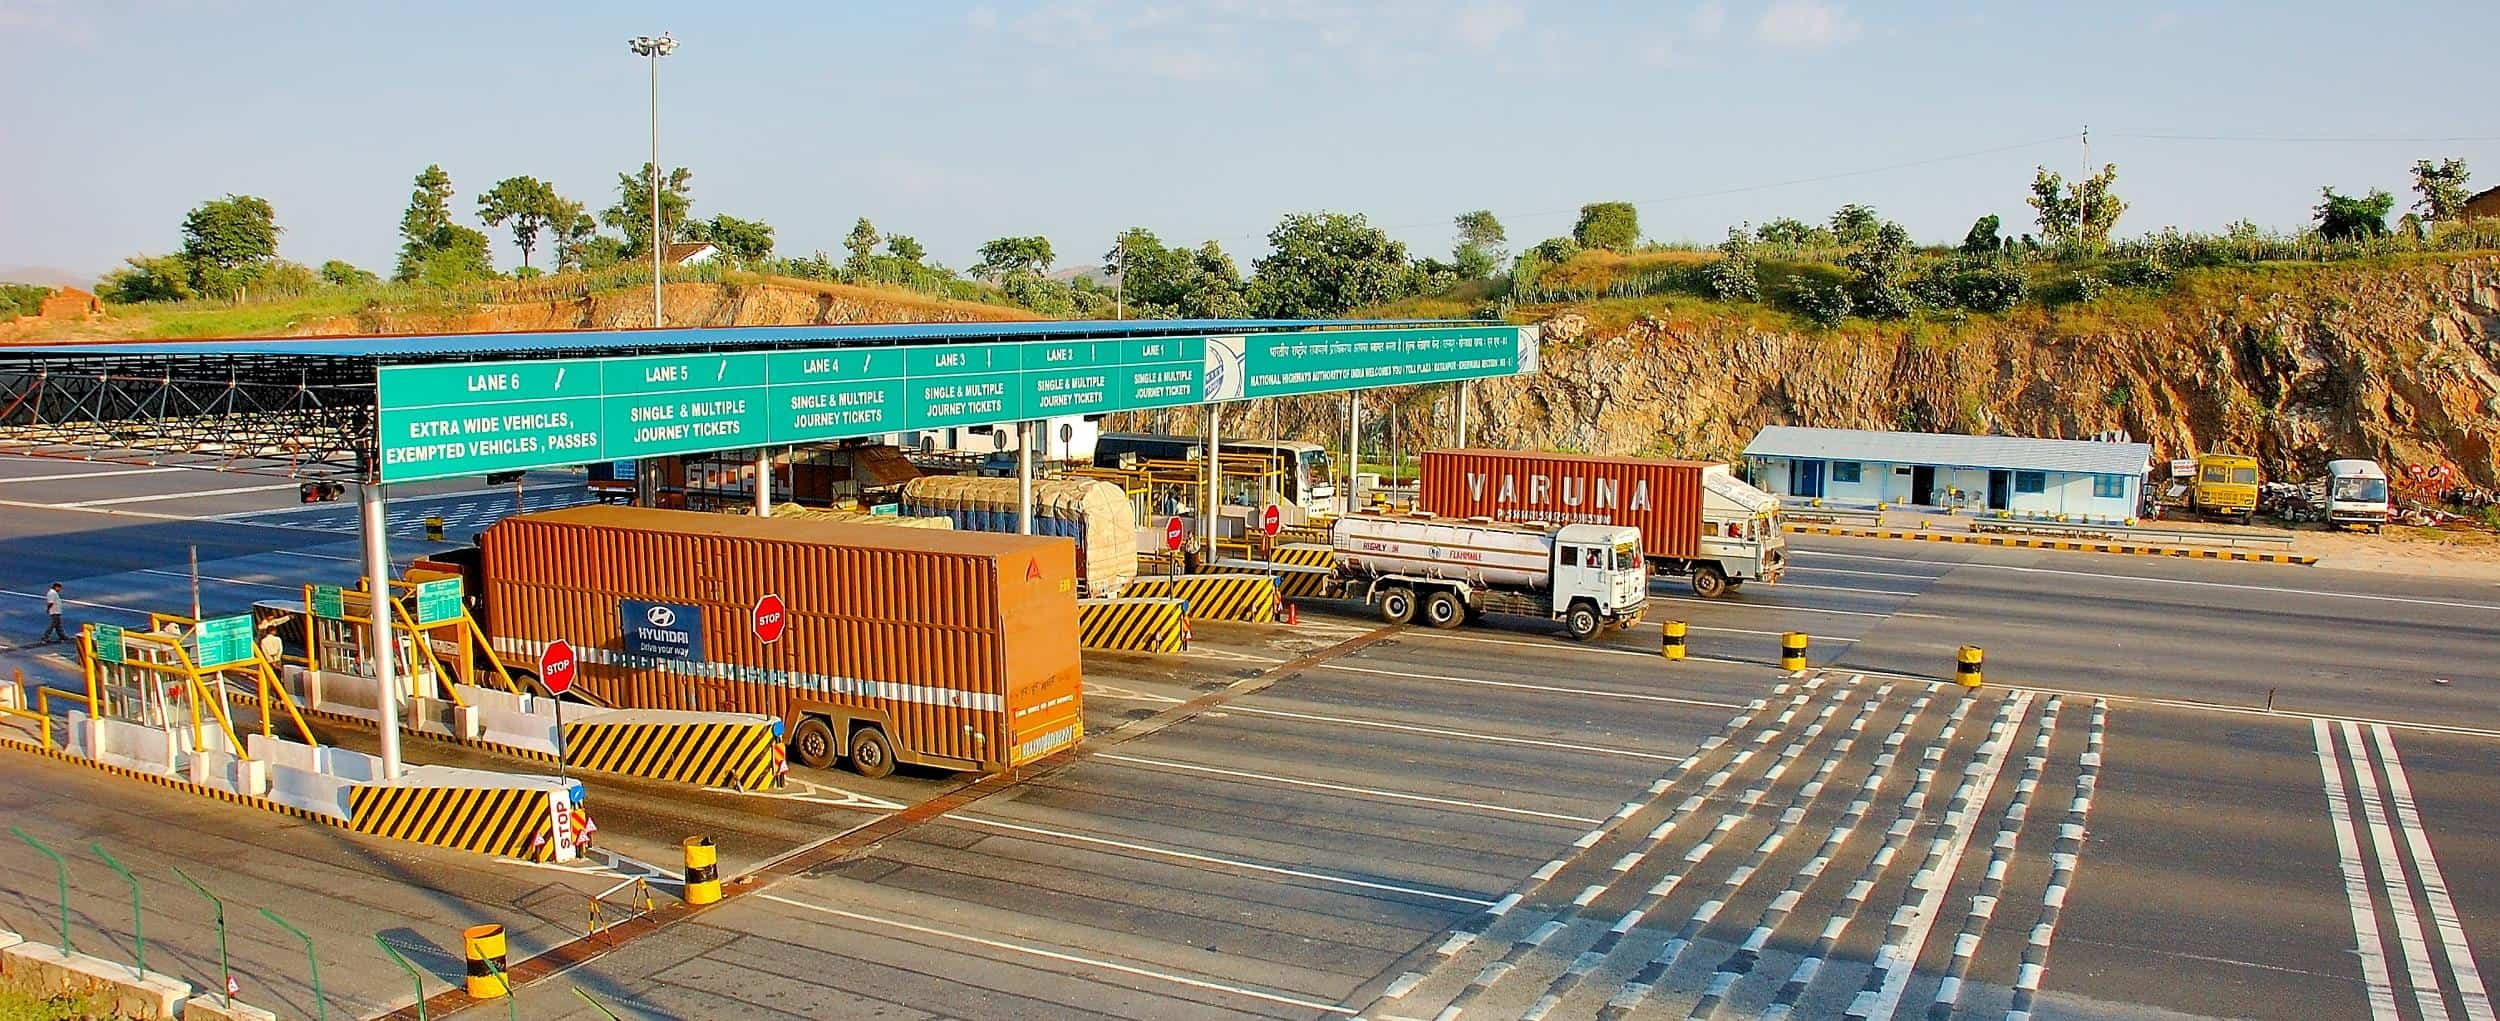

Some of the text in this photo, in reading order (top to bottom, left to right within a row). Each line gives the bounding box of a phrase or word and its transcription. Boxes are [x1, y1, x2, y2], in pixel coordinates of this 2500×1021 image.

[1046, 348, 1073, 361] LANE 2
[1142, 344, 1165, 357] LANE 1
[803, 358, 839, 374] LANE 4
[936, 353, 966, 367] LANE 3
[645, 365, 688, 382] LANE 5
[1134, 370, 1193, 385] SINGLE & MULTIPLE
[1250, 374, 1281, 387] NATIONAL
[1282, 372, 1312, 385] HIGHWAYS
[1312, 369, 1343, 382] AUTHORITY
[1343, 368, 1350, 379] OF
[468, 373, 520, 392] LANE 6
[1037, 376, 1105, 392] SINGLE & MULTIPLE
[791, 390, 884, 410] SINGLE & MULTIPLE
[925, 383, 1004, 400] SINGLE & MULTIPLE
[1039, 392, 1103, 408] JOURNEY TICKETS
[1135, 384, 1191, 399] JOURNEY TICKETS
[630, 399, 745, 422] SINGLE & MULTIPLE
[927, 400, 1002, 417] JOURNEY TICKETS
[794, 409, 882, 428] JOURNEY TICKETS
[410, 420, 461, 439] EXTRA
[463, 417, 499, 434] WIDE
[633, 420, 740, 443] JOURNEY TICKETS
[386, 442, 466, 465] EXEMPTED
[468, 436, 538, 457] VEHICLES
[548, 432, 597, 449] PASSES
[1467, 473, 1651, 511] VARUNA
[1363, 543, 1387, 552] HIGHLY
[759, 612, 781, 626] STOP
[638, 627, 689, 644] HYUNDAI
[674, 647, 689, 658] way
[546, 659, 570, 676] STOP
[557, 800, 571, 849] STOP
